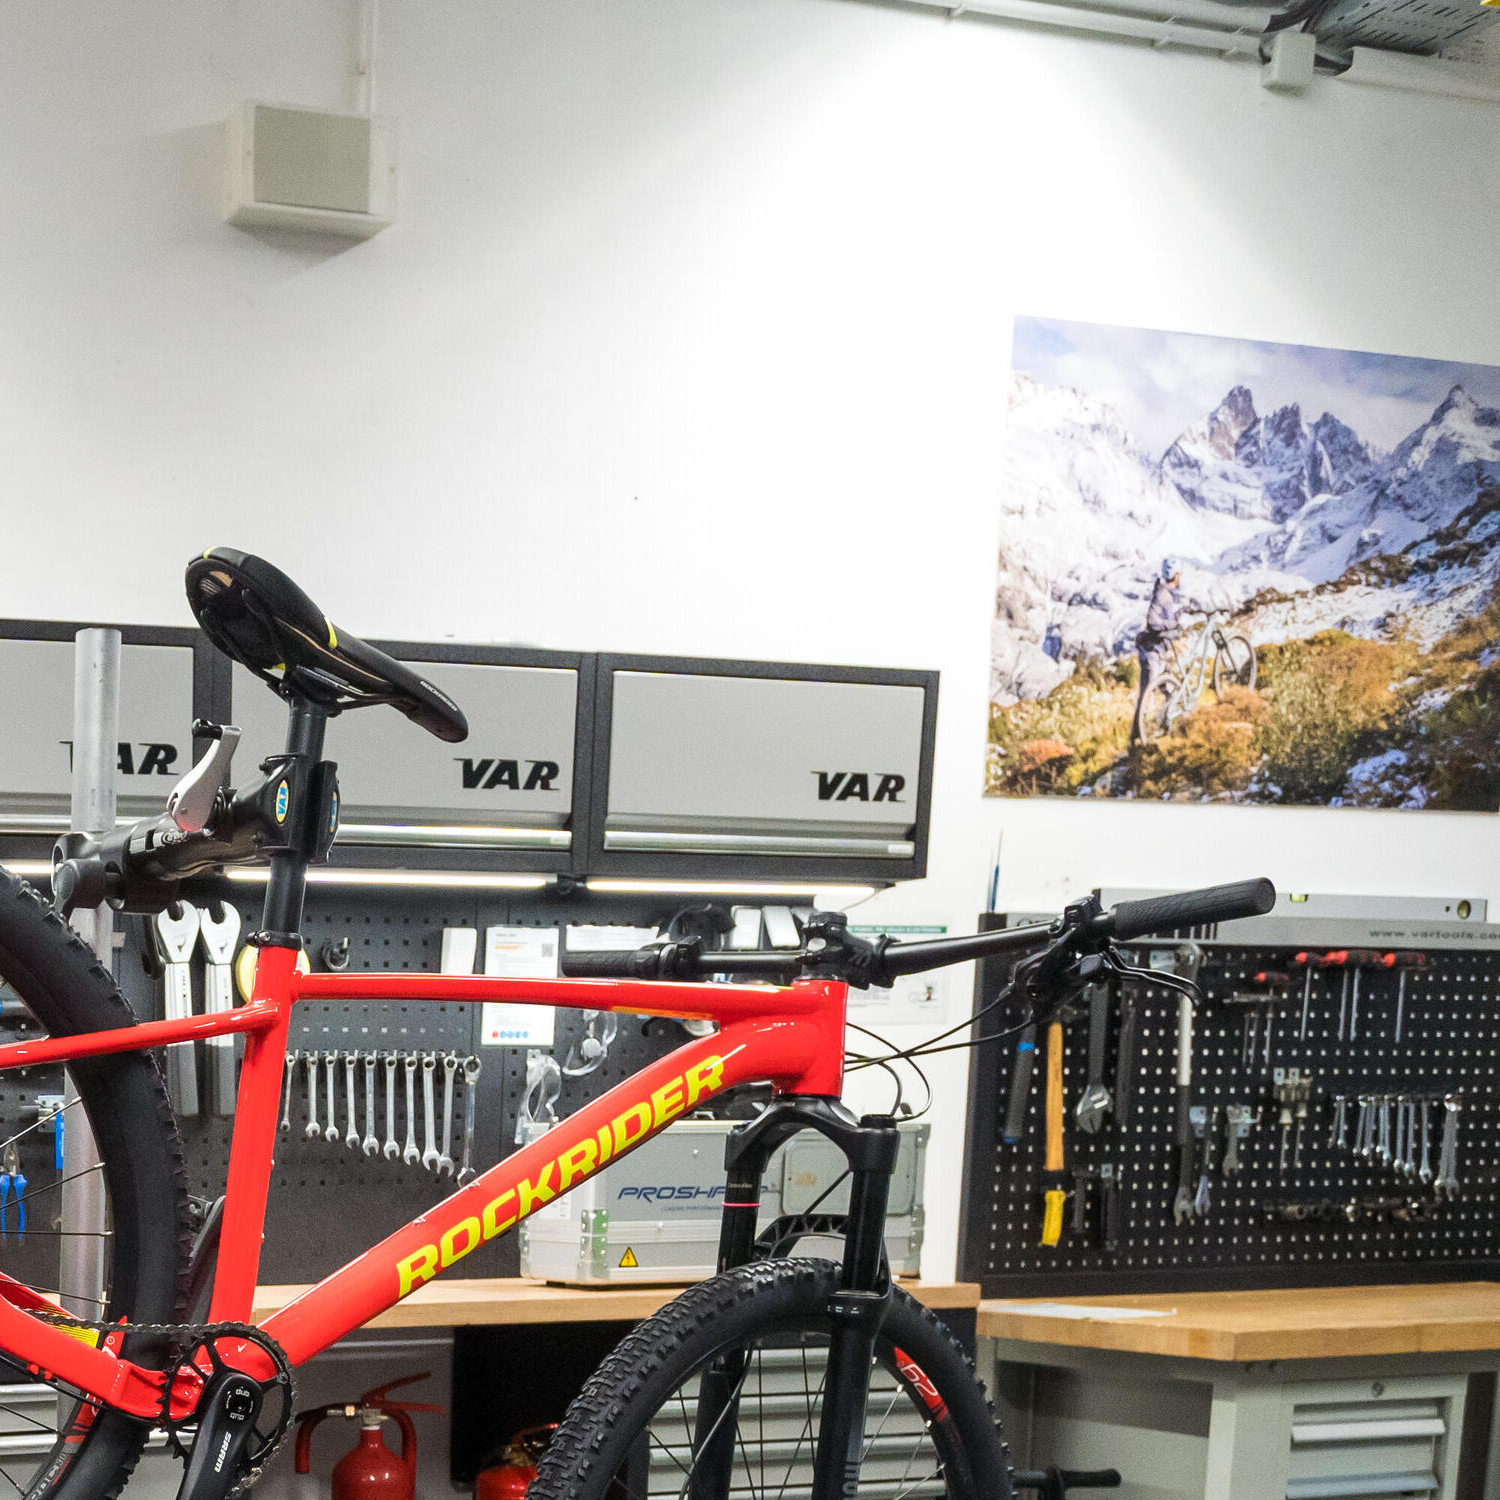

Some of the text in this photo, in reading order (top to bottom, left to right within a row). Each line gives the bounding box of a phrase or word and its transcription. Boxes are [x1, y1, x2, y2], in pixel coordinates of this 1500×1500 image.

[453, 757, 561, 791] VAR
[810, 771, 906, 802] VAR
[1369, 928, 1500, 940] www.vartools.co
[397, 1055, 725, 1299] ROCKRIDER
[235, 1388, 250, 1397] dub
[214, 1431, 232, 1473] SRAM
